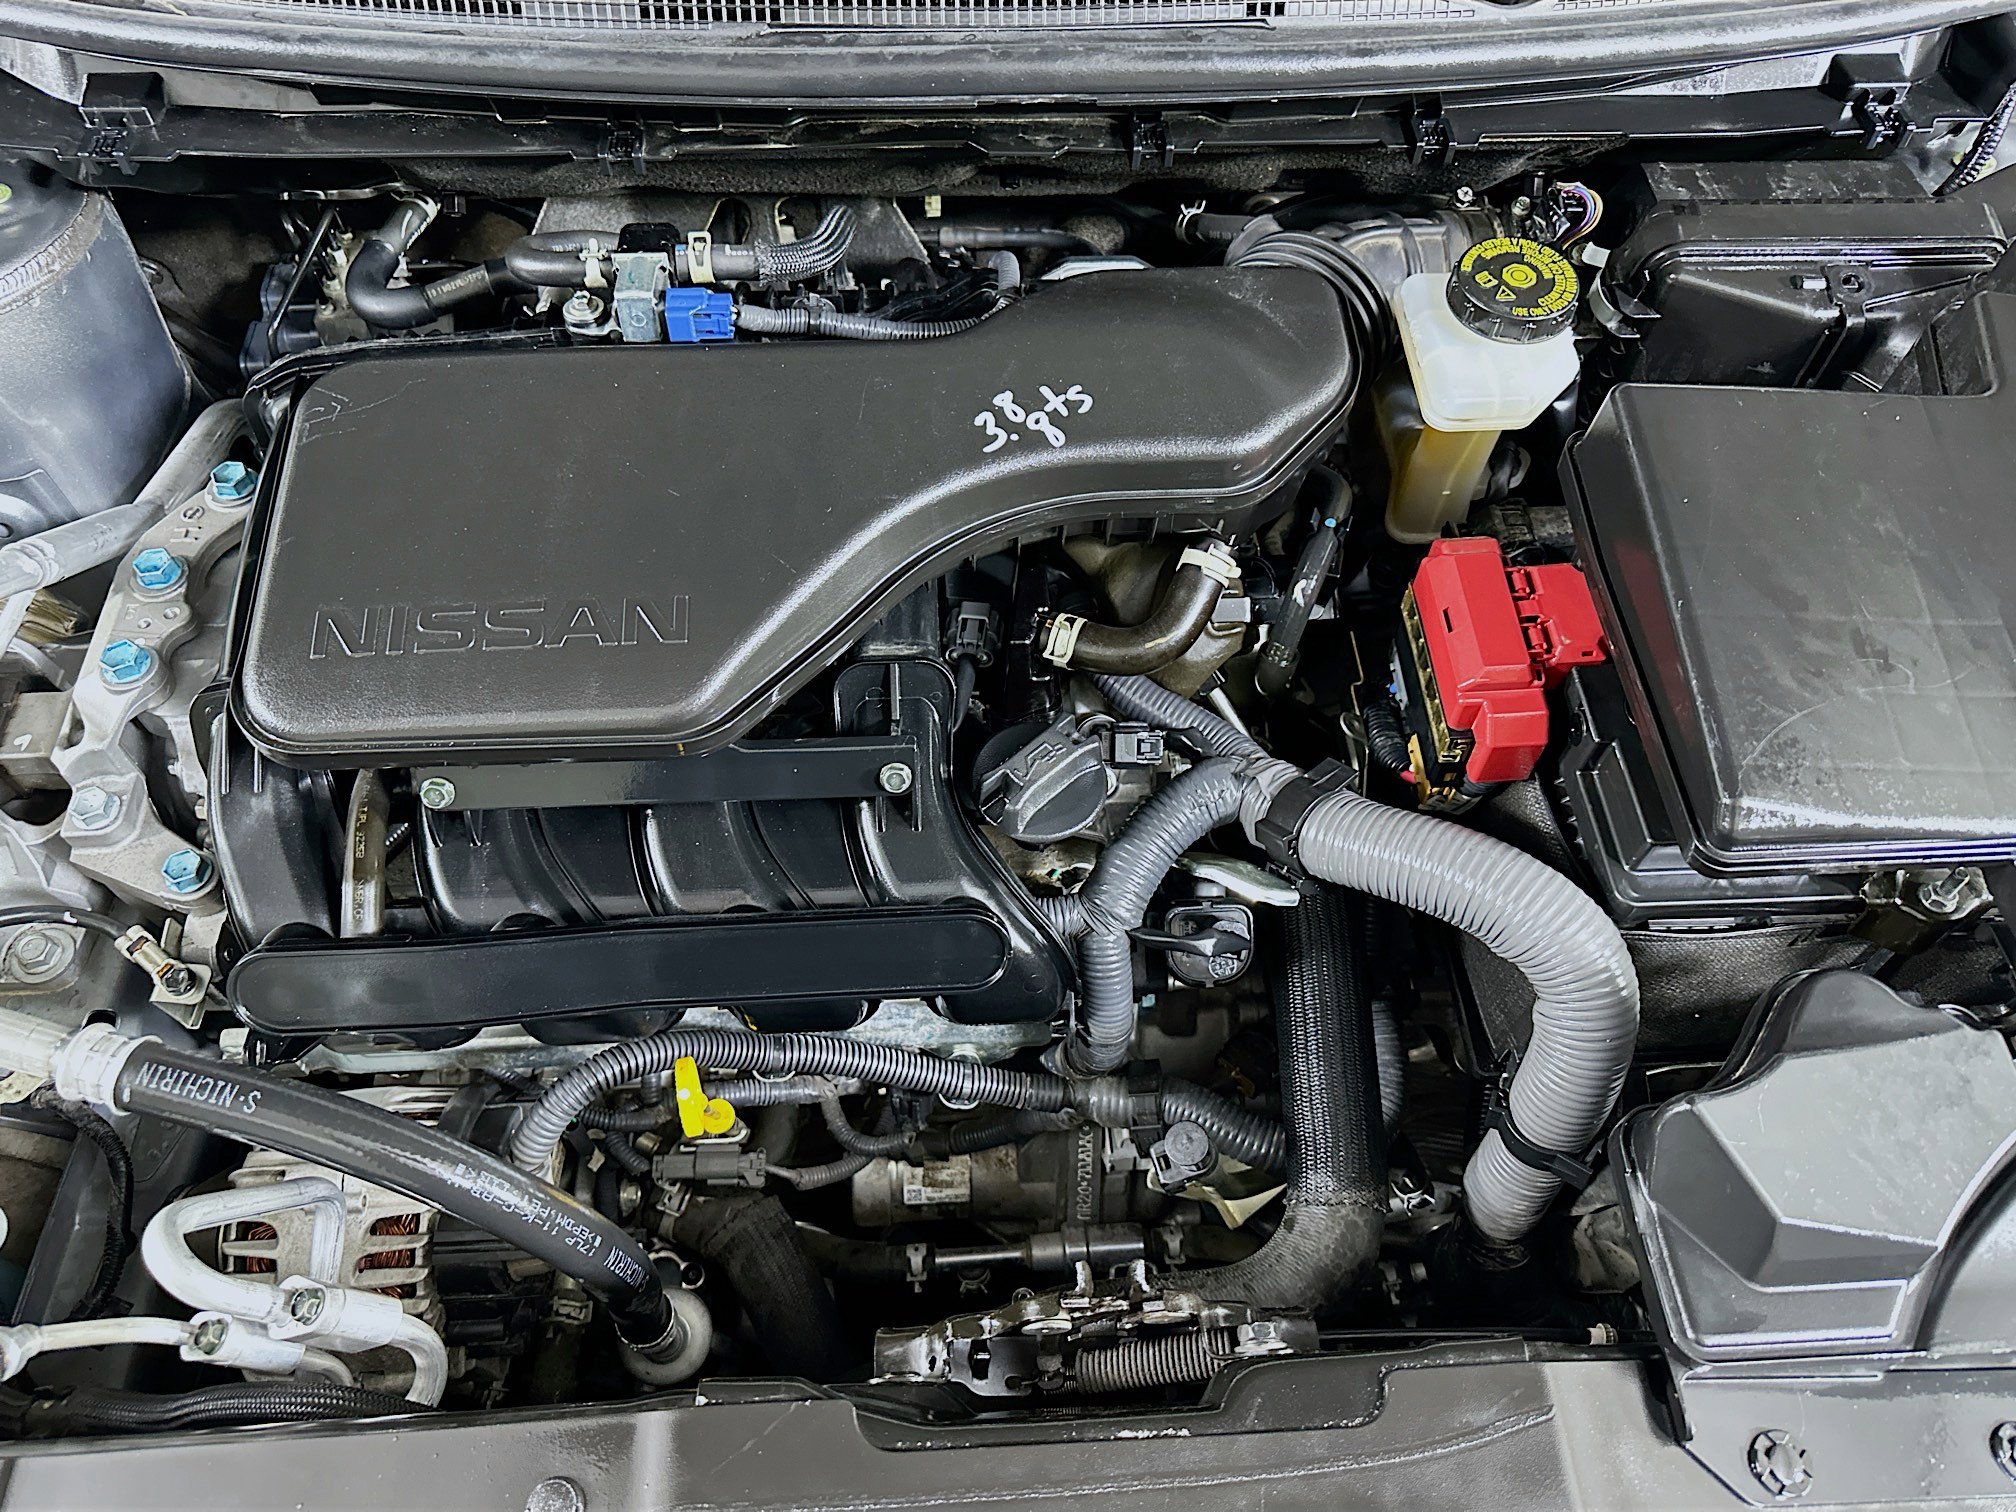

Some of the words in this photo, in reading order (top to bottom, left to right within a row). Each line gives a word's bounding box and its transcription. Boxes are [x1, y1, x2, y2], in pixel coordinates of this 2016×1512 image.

[1519, 238, 1542, 252] FROM
[1521, 245, 1553, 264] BEFORE
[1541, 246, 1563, 262] FLUID
[1524, 255, 1554, 279] WARNING
[1512, 306, 1529, 316] USE
[1530, 306, 1551, 316] ONLY
[974, 390, 1026, 453] 3.8
[309, 594, 690, 661] NISSAN
